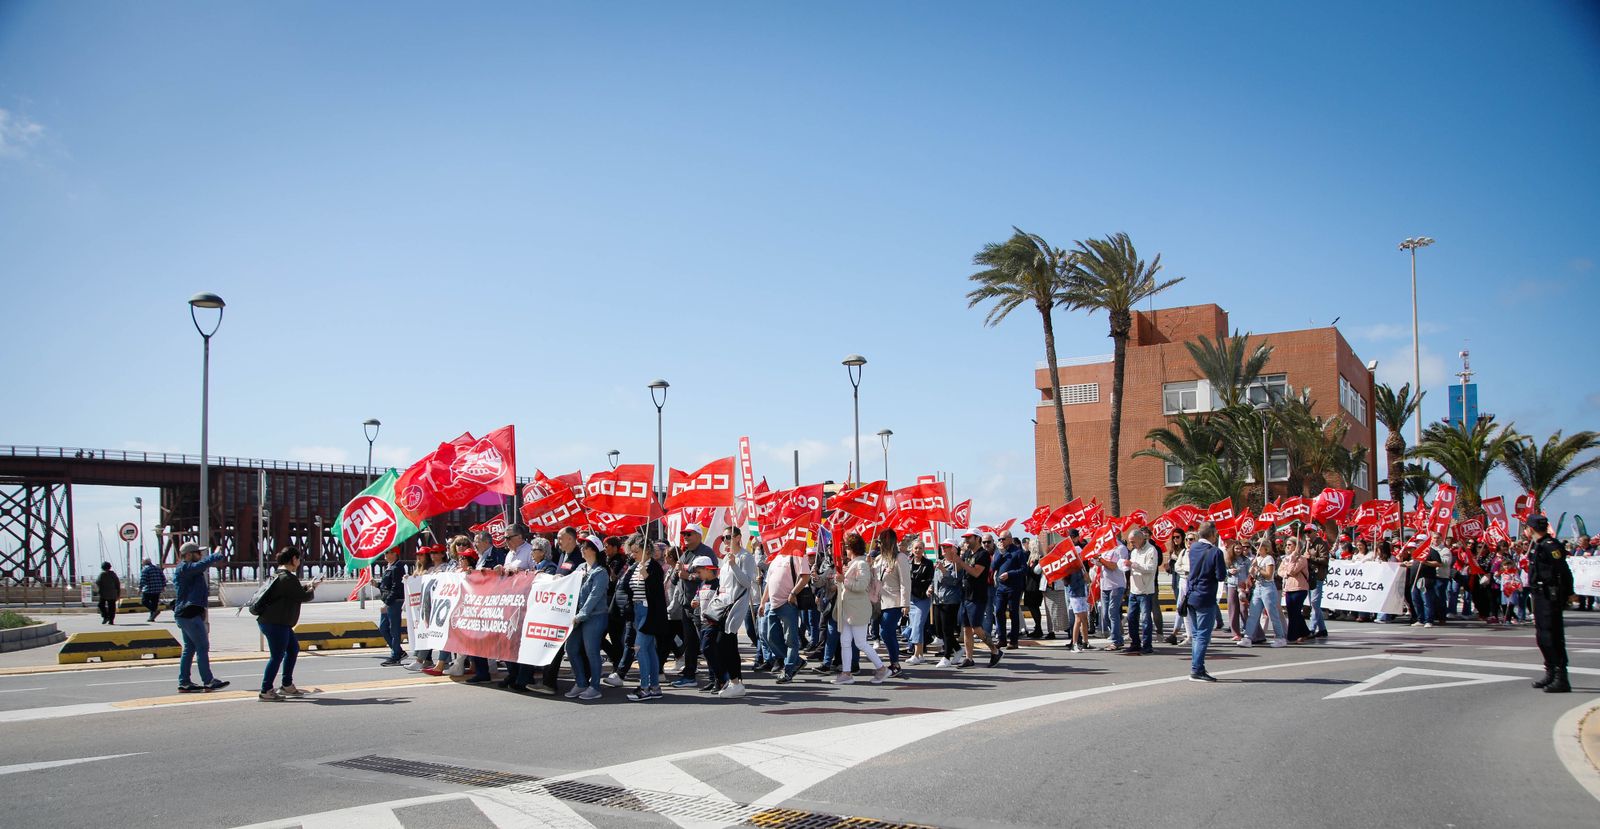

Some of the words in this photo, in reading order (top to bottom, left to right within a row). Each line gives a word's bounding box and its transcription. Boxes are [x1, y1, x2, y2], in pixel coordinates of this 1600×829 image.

[740, 440, 756, 519] CCOO
[1328, 566, 1341, 576] OR
[1345, 568, 1364, 577] UNA
[1343, 578, 1385, 591] PÚBLICA
[535, 591, 557, 604] UGT
[1326, 592, 1368, 603] CALIDAD
